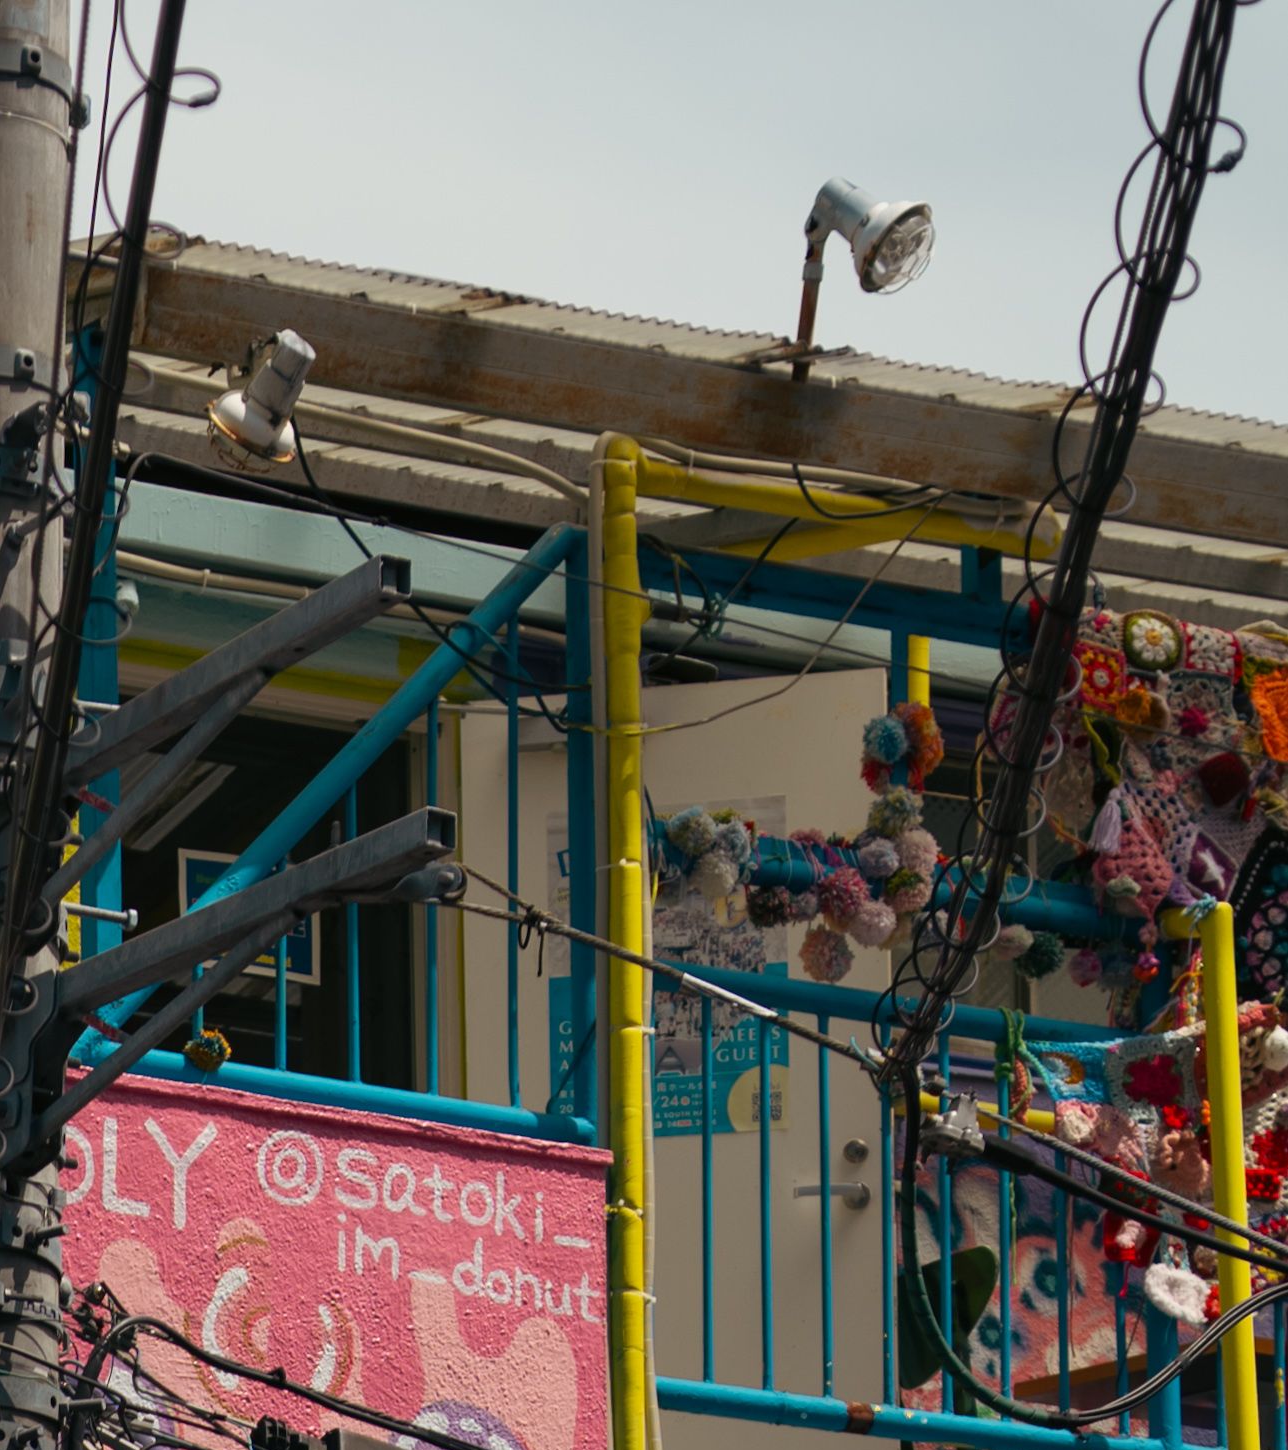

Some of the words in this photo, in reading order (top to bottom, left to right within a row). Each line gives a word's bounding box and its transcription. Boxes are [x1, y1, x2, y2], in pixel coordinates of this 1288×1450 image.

[719, 1027, 780, 1042] MEES
[716, 1047, 780, 1063] GUET
[335, 1228, 603, 1325] im_donut
